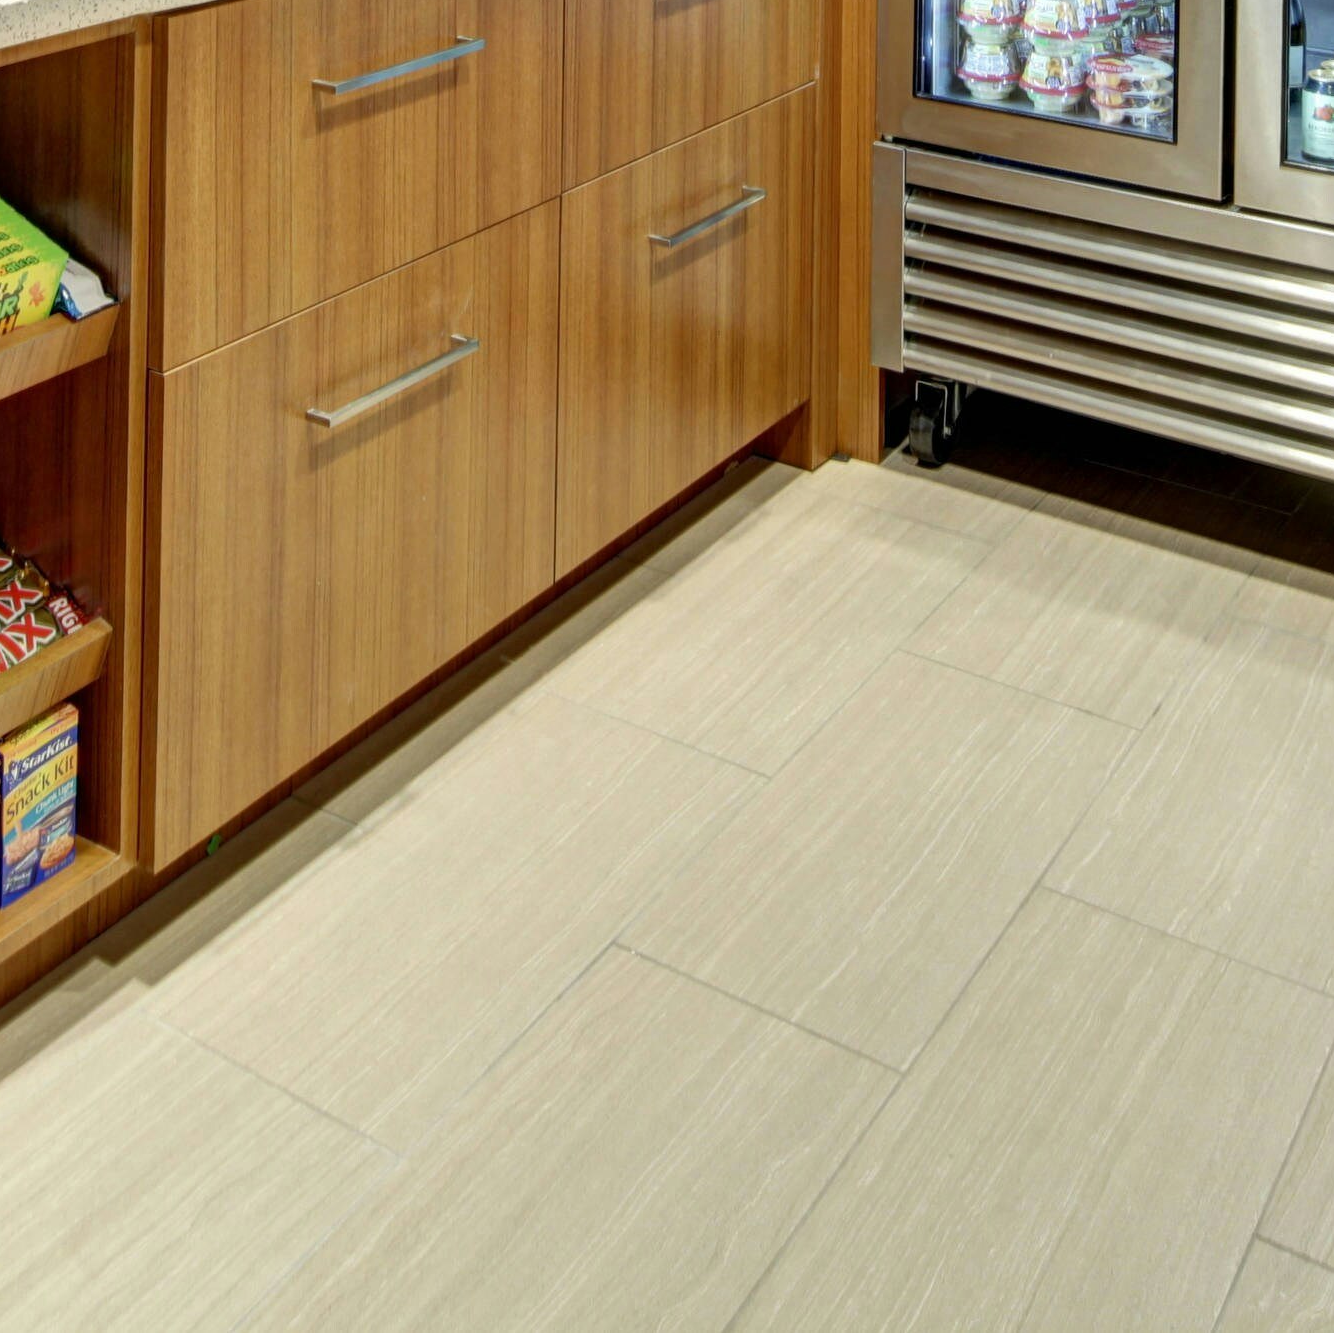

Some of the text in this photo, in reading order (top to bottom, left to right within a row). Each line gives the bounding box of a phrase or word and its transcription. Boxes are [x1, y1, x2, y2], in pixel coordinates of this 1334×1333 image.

[19, 735, 71, 774] StarKist
[5, 753, 74, 824] Snack Kit
